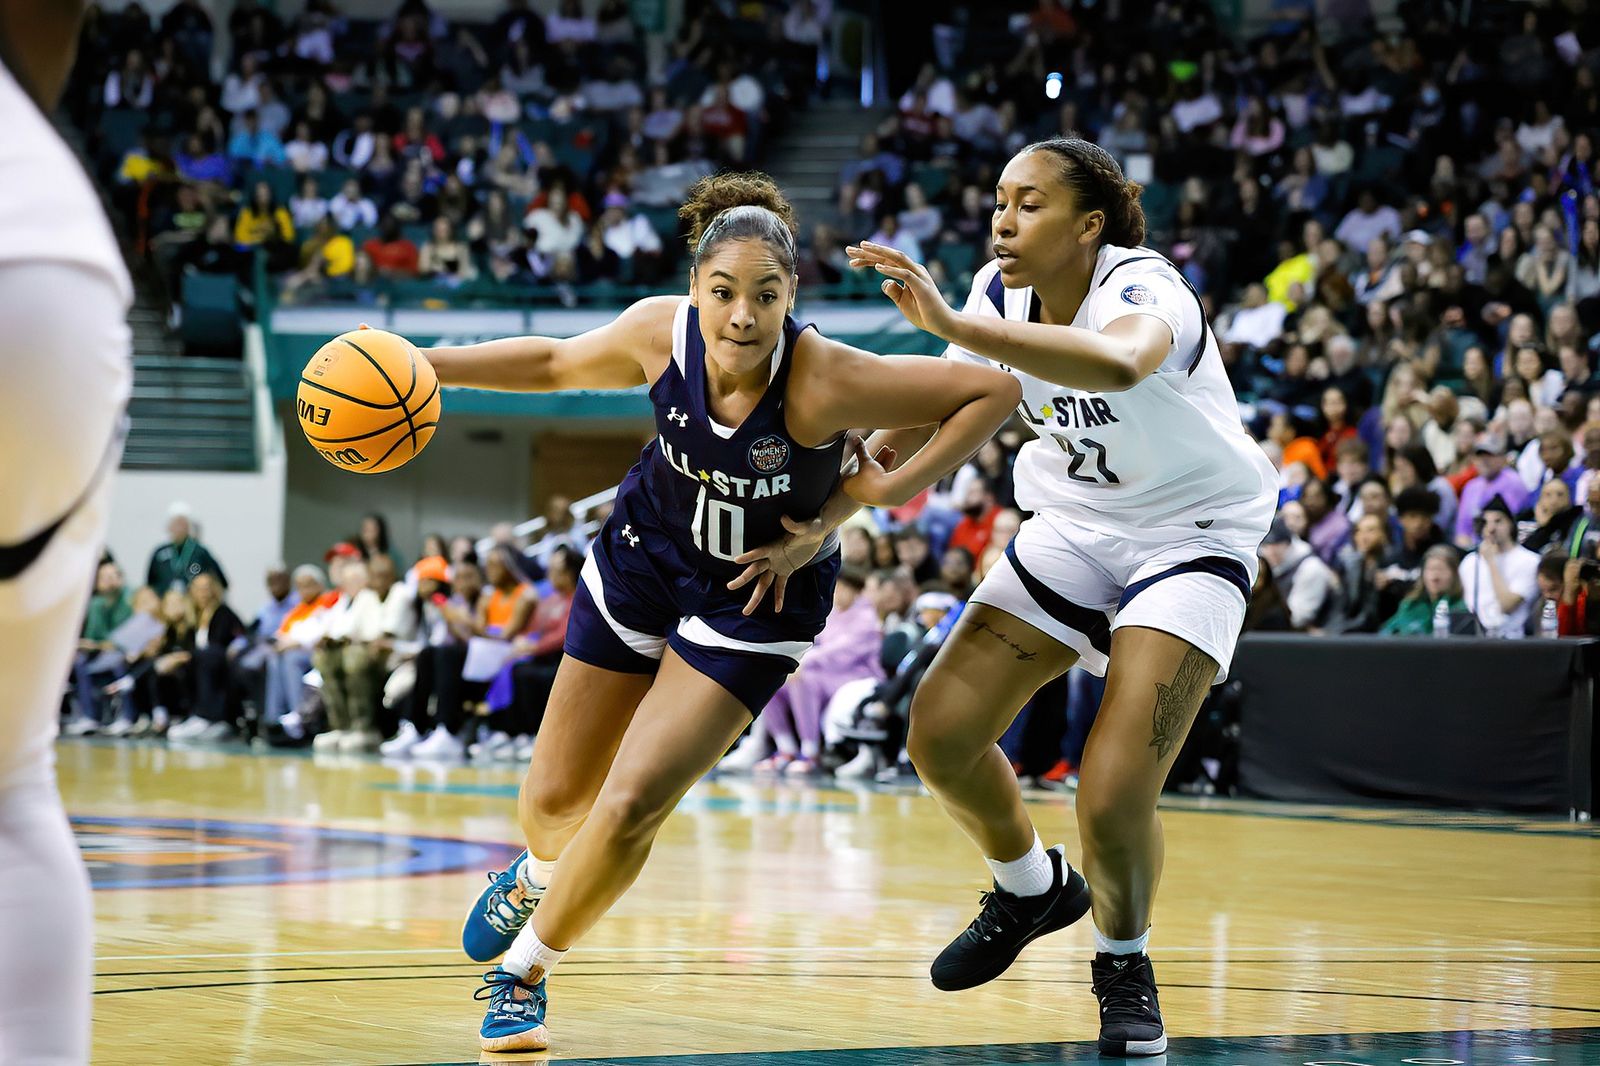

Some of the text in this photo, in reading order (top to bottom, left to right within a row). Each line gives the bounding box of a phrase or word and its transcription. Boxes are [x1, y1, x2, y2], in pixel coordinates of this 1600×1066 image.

[1052, 396, 1120, 428] STAR
[752, 445, 787, 457] WOMEN'S
[712, 469, 791, 499] STAR
[691, 484, 744, 562] 10
